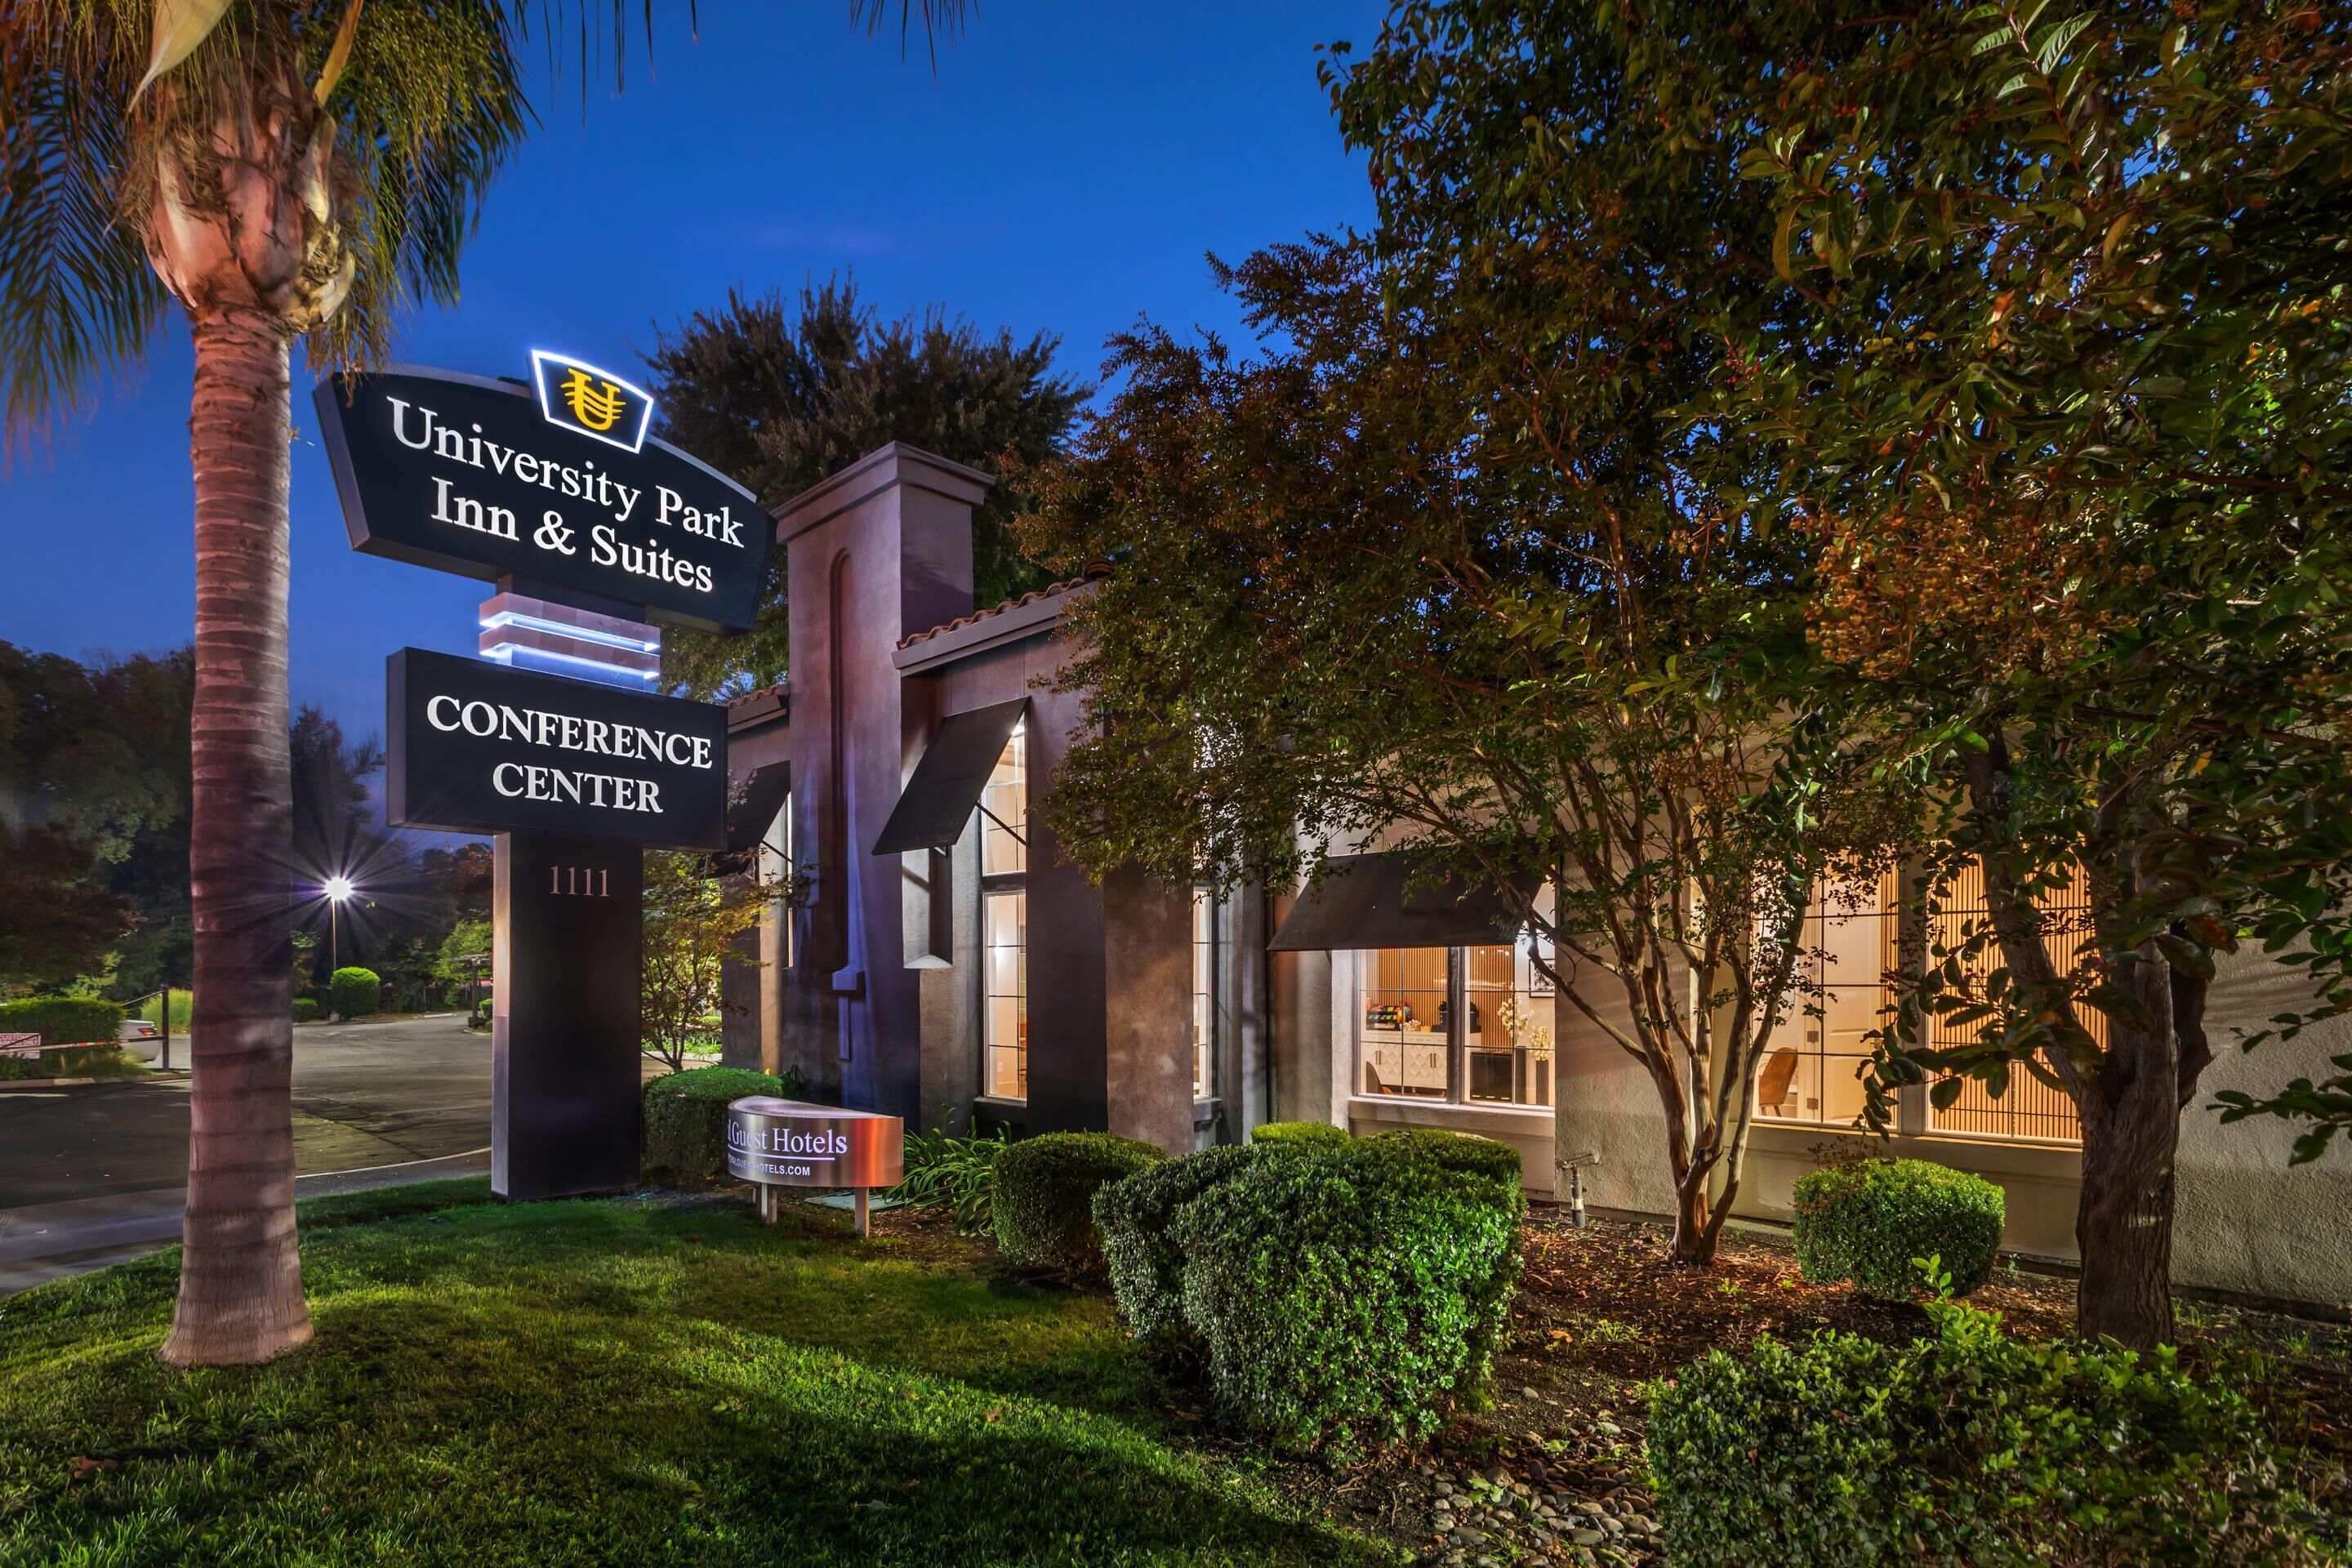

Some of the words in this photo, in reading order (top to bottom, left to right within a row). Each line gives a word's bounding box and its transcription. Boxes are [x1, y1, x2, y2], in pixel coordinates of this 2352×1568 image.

[385, 395, 641, 522] University
[655, 484, 745, 548] Park
[430, 476, 519, 542] Inn
[532, 510, 577, 555] &
[591, 524, 713, 593] Suites
[426, 695, 713, 769] CONFERENCE
[492, 762, 664, 813] CENTER
[550, 866, 611, 898] 1111
[732, 1121, 768, 1150] Guest
[772, 1128, 848, 1154] Hotels
